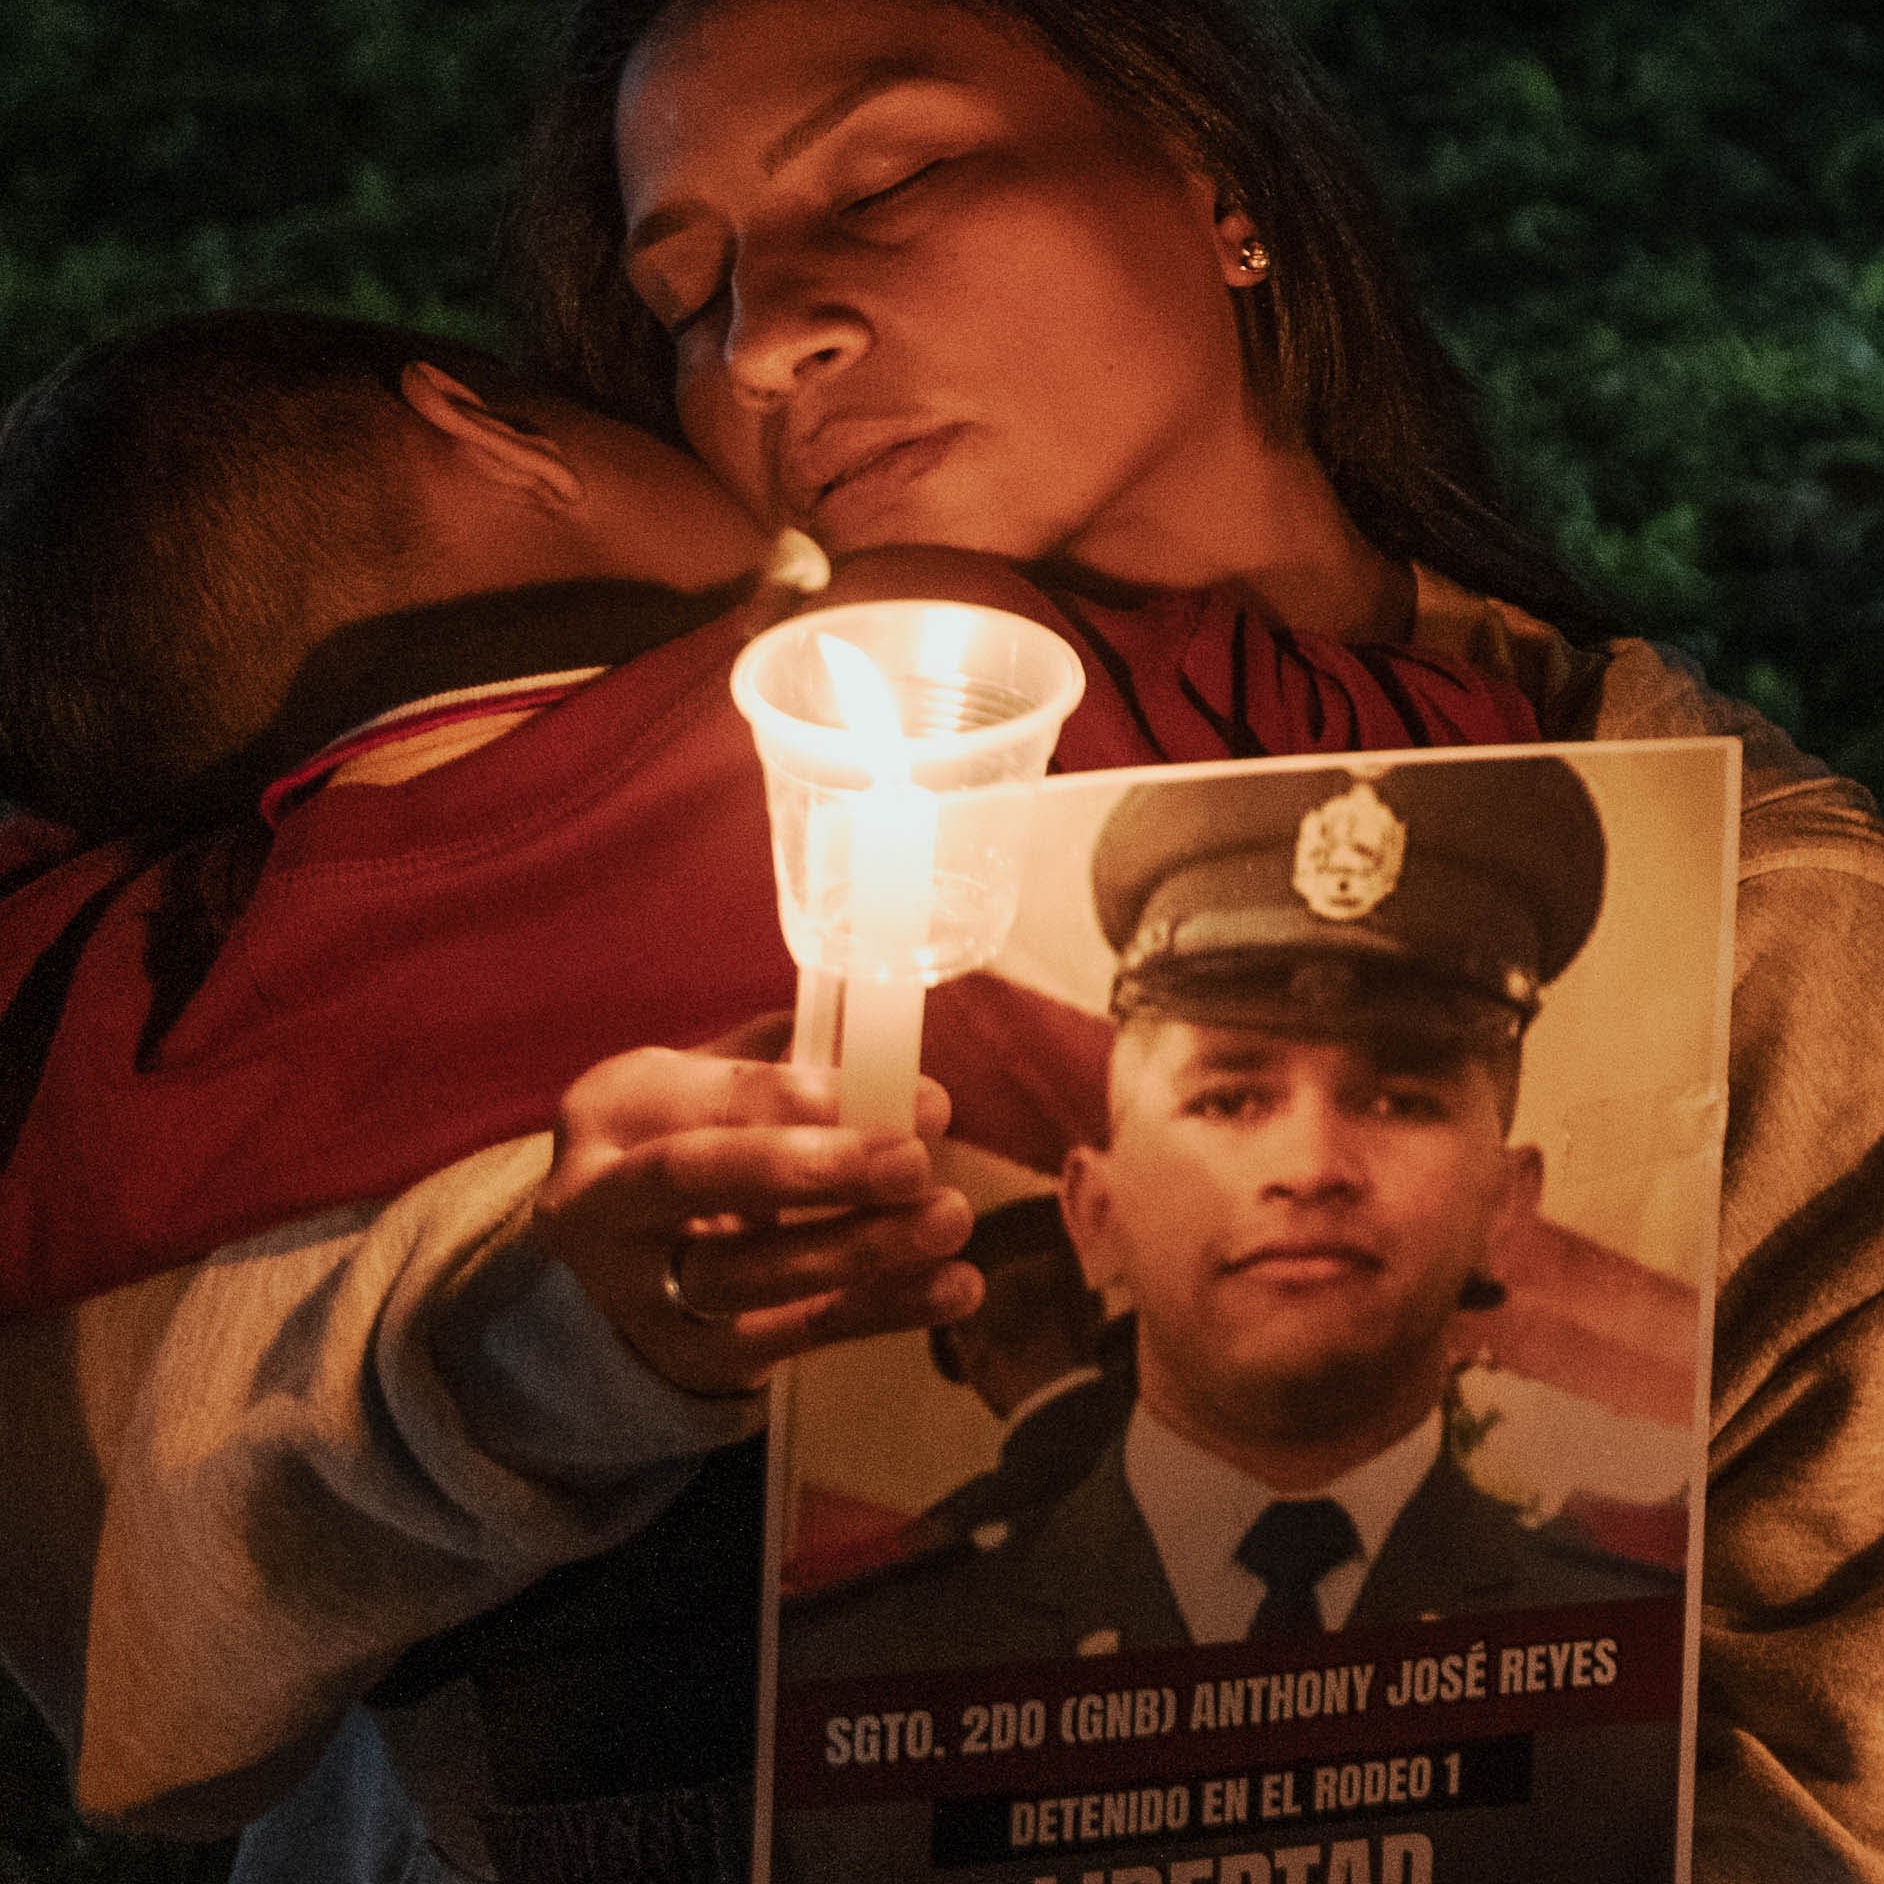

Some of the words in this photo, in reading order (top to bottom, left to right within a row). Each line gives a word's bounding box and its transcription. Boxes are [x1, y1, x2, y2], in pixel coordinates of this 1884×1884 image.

[824, 1708, 946, 1766] SGTO.
[961, 1696, 1047, 1756] 2DO
[1060, 1687, 1179, 1747] (GNB)
[1190, 1660, 1376, 1733] ANTHONY
[1387, 1641, 1488, 1708] JOSÉ
[1497, 1636, 1620, 1698] REYES
[1009, 1784, 1191, 1848] DETENIDO
[1202, 1777, 1249, 1828] EN
[1260, 1770, 1303, 1819] EL
[1313, 1756, 1432, 1813] RODEO
[1443, 1751, 1463, 1797] 1
